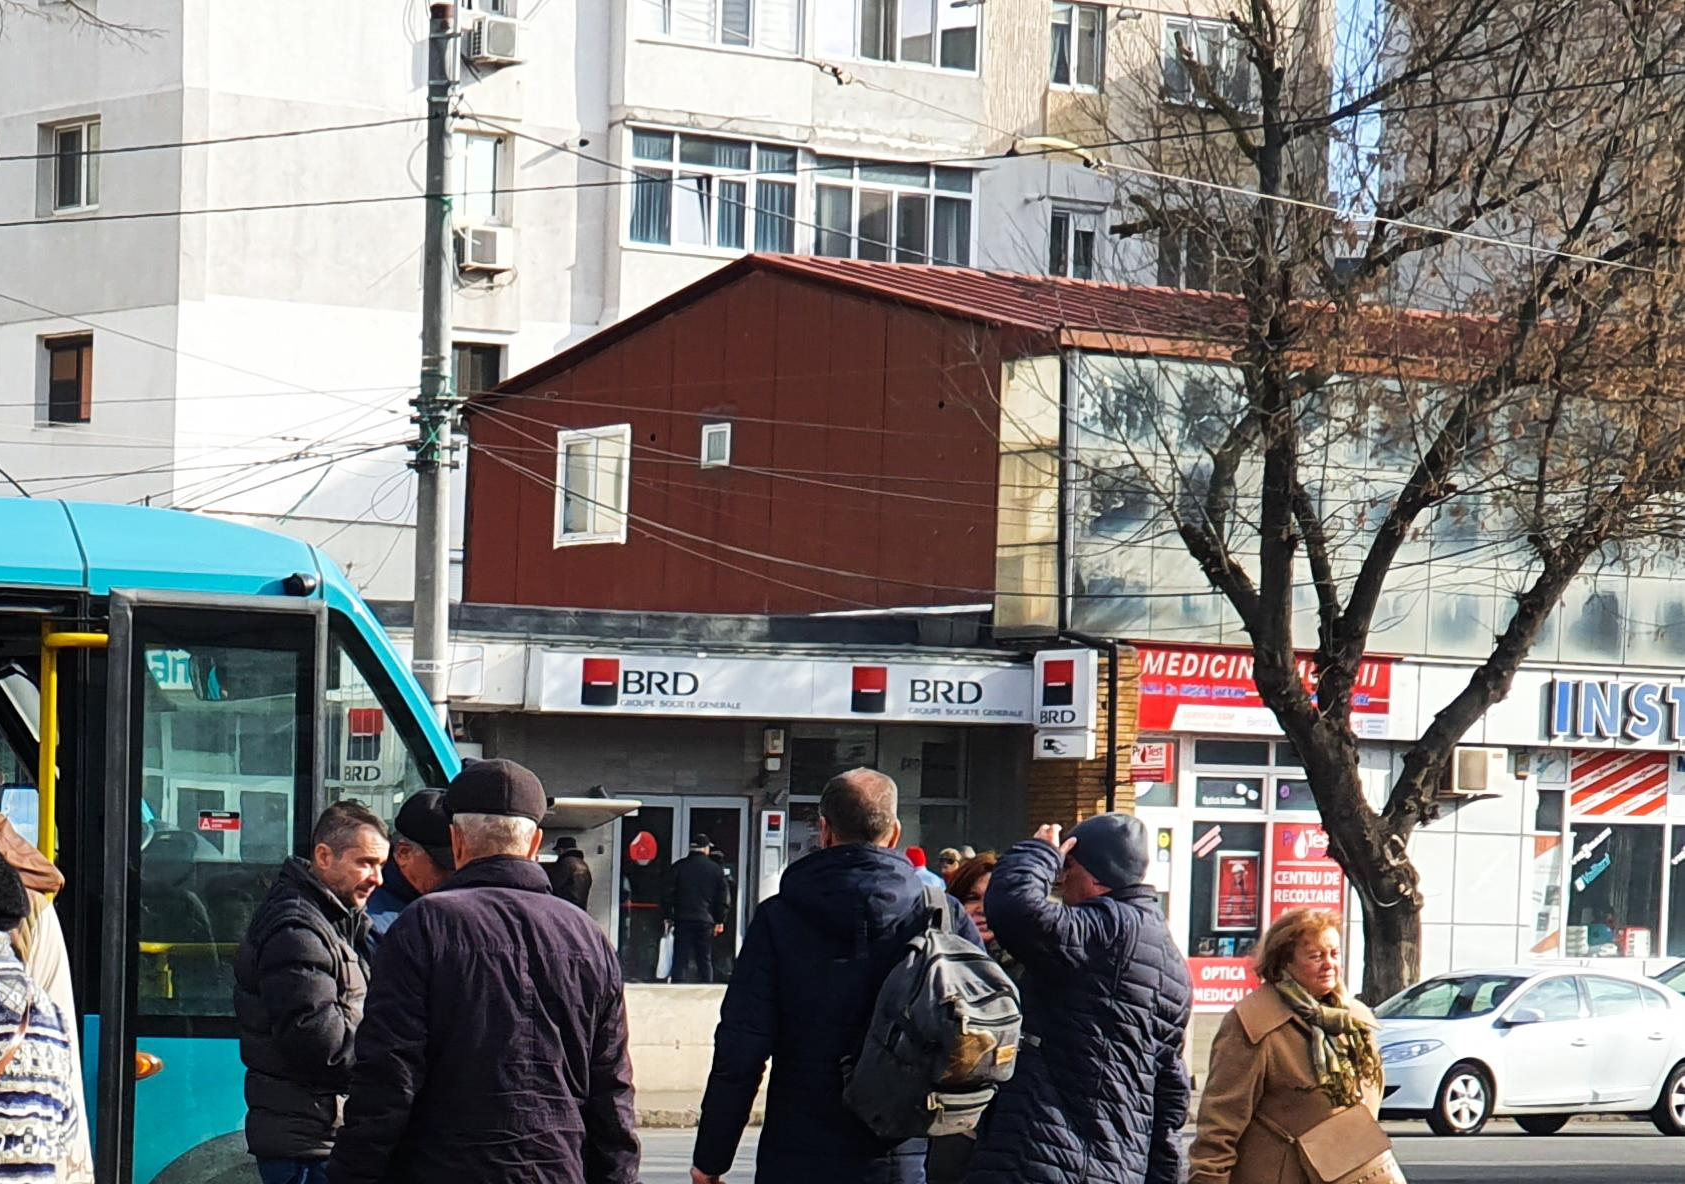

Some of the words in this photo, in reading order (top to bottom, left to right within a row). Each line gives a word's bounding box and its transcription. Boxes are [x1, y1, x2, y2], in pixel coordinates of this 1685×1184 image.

[1142, 652, 1254, 680] MEDICIN
[622, 670, 699, 696] BRD
[910, 679, 983, 704] BRD
[1039, 710, 1076, 724] BRD
[344, 766, 381, 782] BRD
[1274, 871, 1321, 885] CENTRU
[1323, 872, 1340, 885] DE
[1274, 889, 1340, 903] RECOLTARE
[1201, 966, 1246, 981] OPTICA
[1193, 988, 1254, 1002] MEDICAL
